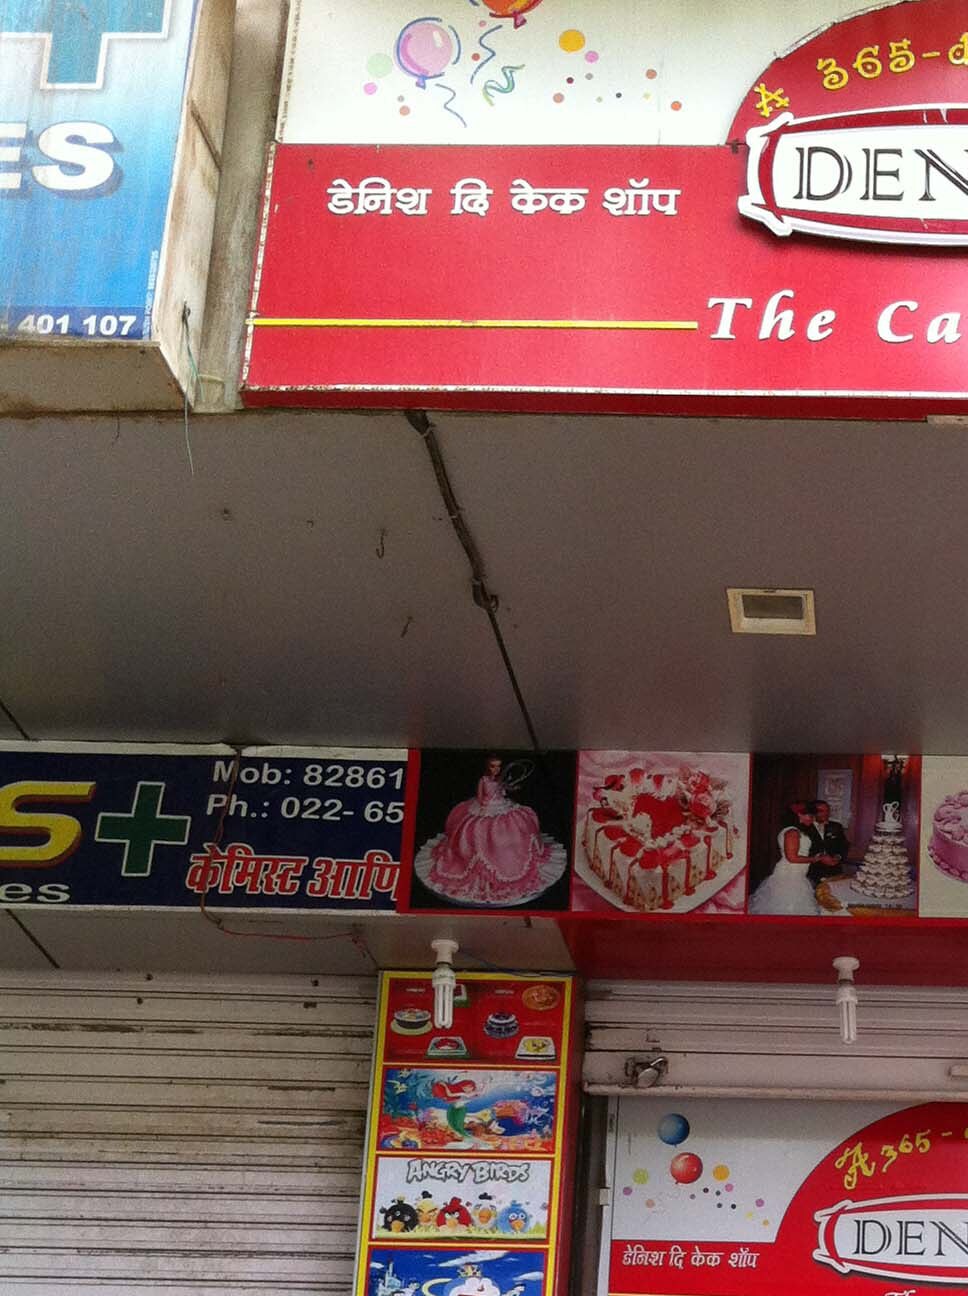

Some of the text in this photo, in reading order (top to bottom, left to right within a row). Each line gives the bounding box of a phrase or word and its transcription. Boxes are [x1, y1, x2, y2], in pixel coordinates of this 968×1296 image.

[327, 177, 681, 216] डेनिश दि केक शॉप
[16, 313, 137, 336] 401 107
[708, 290, 837, 342] The
[213, 760, 403, 789] Mob: 82861
[406, 1158, 532, 1184] ANGRY BIRDS
[622, 1244, 761, 1270] डेनिश दि केक शॉप
